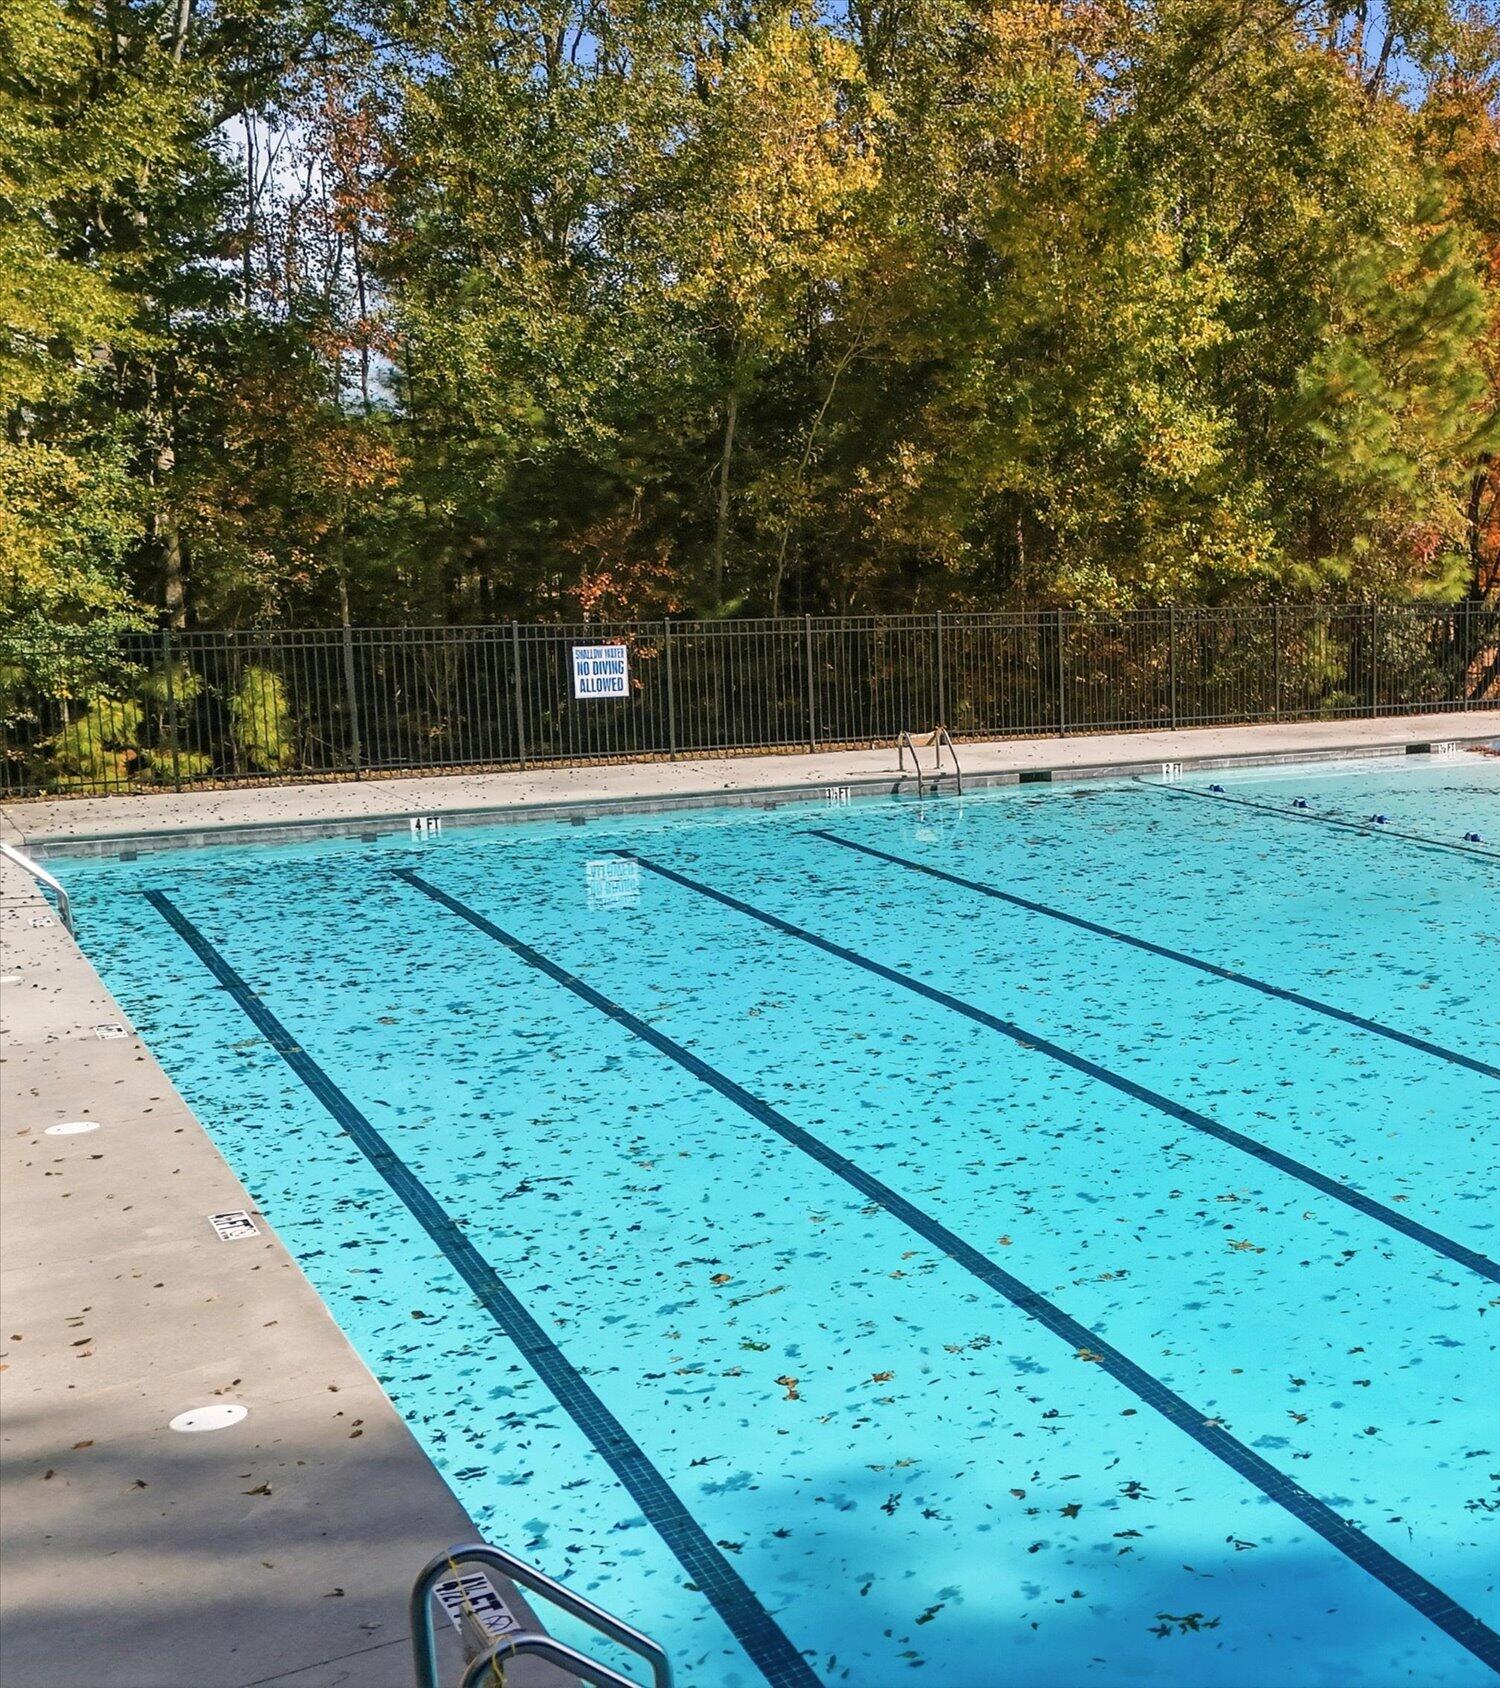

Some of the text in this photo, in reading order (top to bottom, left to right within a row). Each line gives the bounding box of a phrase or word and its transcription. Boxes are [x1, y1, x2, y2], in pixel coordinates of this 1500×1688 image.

[577, 660, 625, 676] NO DIVING
[580, 677, 624, 693] ALLOWED
[1165, 763, 1171, 774] 2
[839, 786, 849, 799] FT
[415, 817, 440, 831] 4 FT
